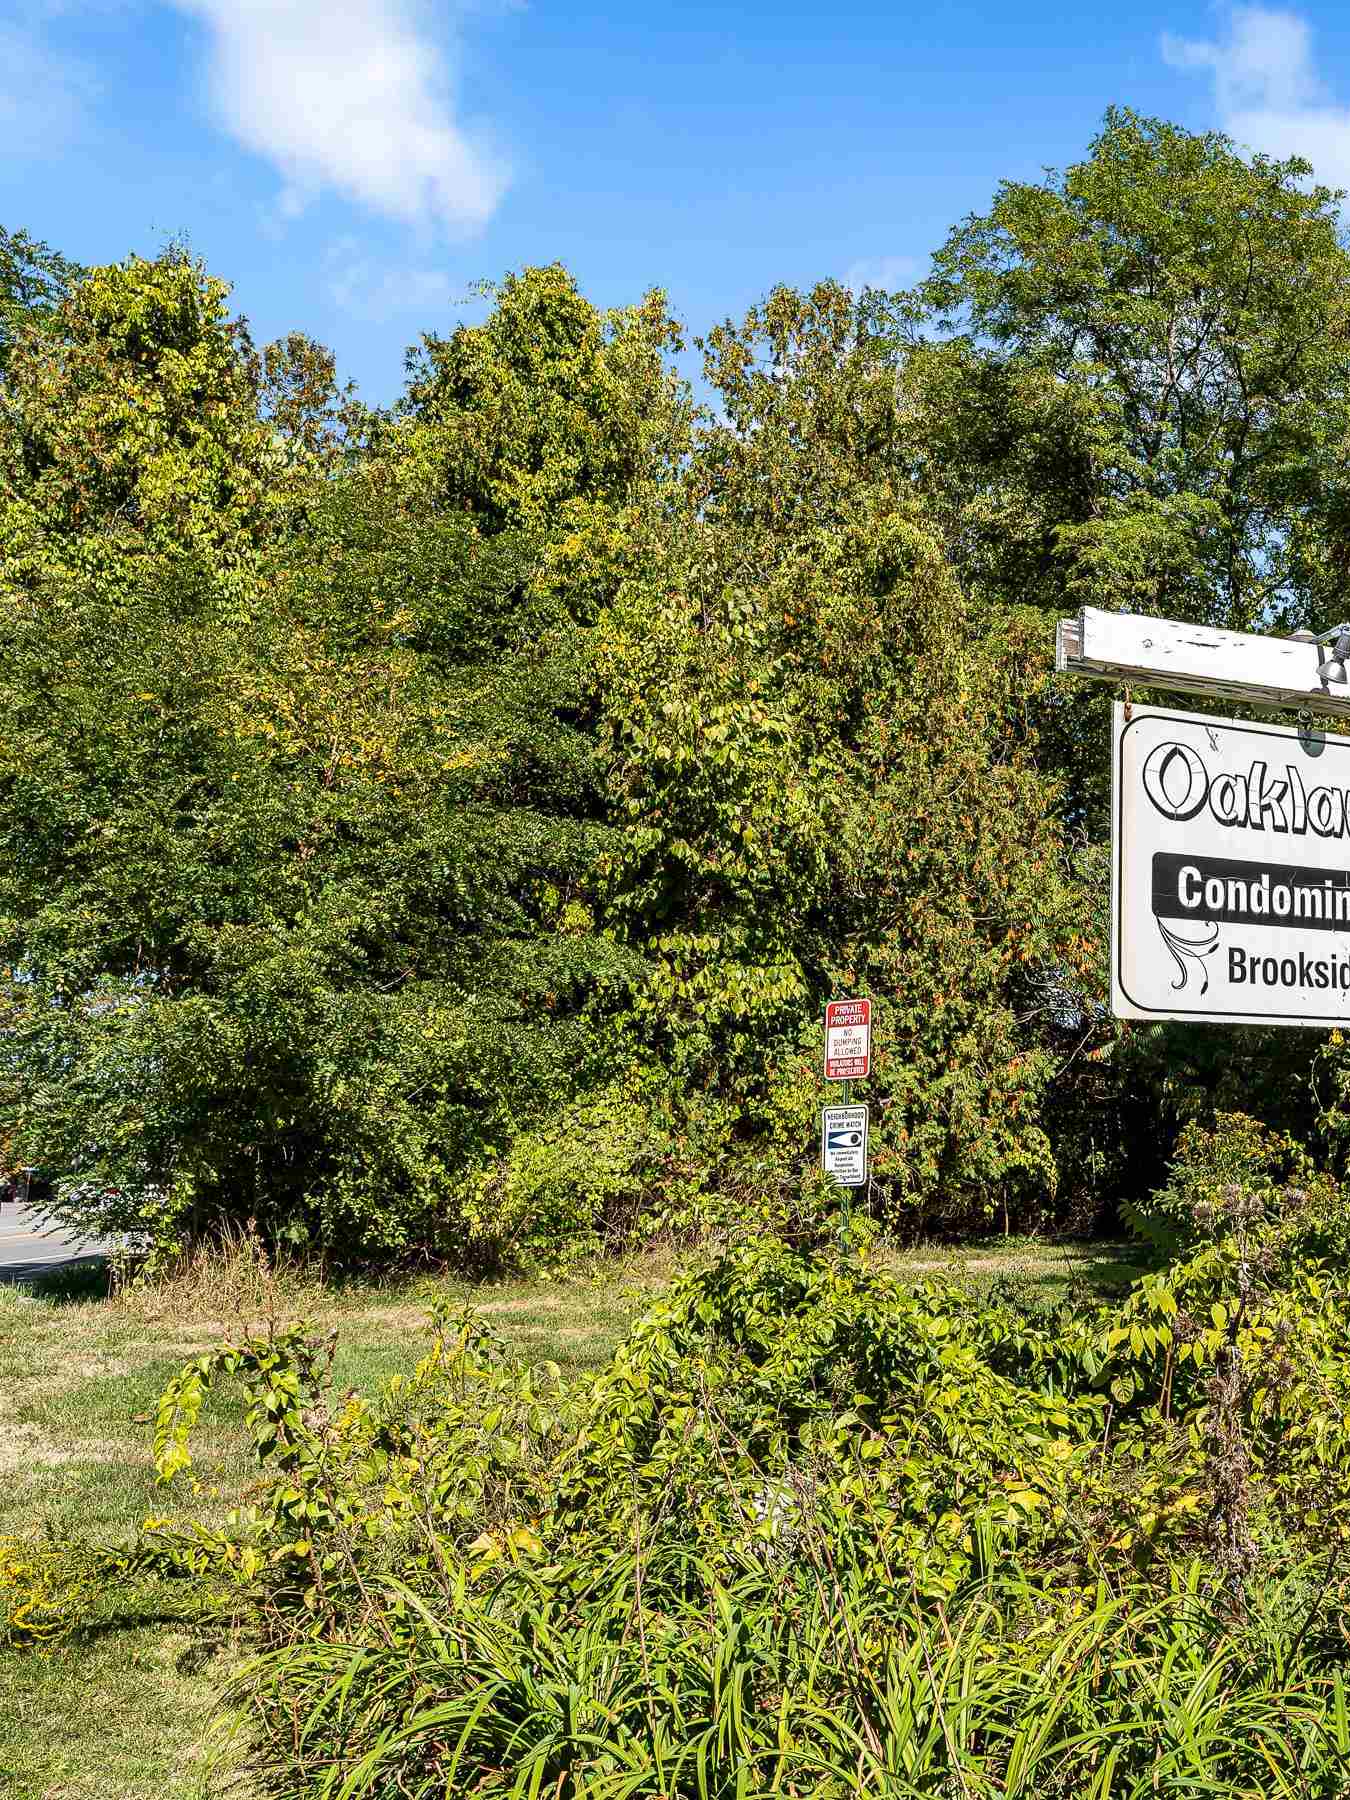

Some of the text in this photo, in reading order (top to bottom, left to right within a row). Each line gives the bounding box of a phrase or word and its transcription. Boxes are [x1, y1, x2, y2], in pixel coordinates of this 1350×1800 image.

[834, 1004, 863, 1015] PRIVATE
[831, 1014, 866, 1025] PROPERTY
[843, 1028, 853, 1037] NO
[834, 1037, 862, 1047] DUMPING
[834, 1047, 862, 1057] ALLOWED
[827, 1111, 864, 1120] NEIGHBORHOOD
[847, 1120, 862, 1128] WATCH
